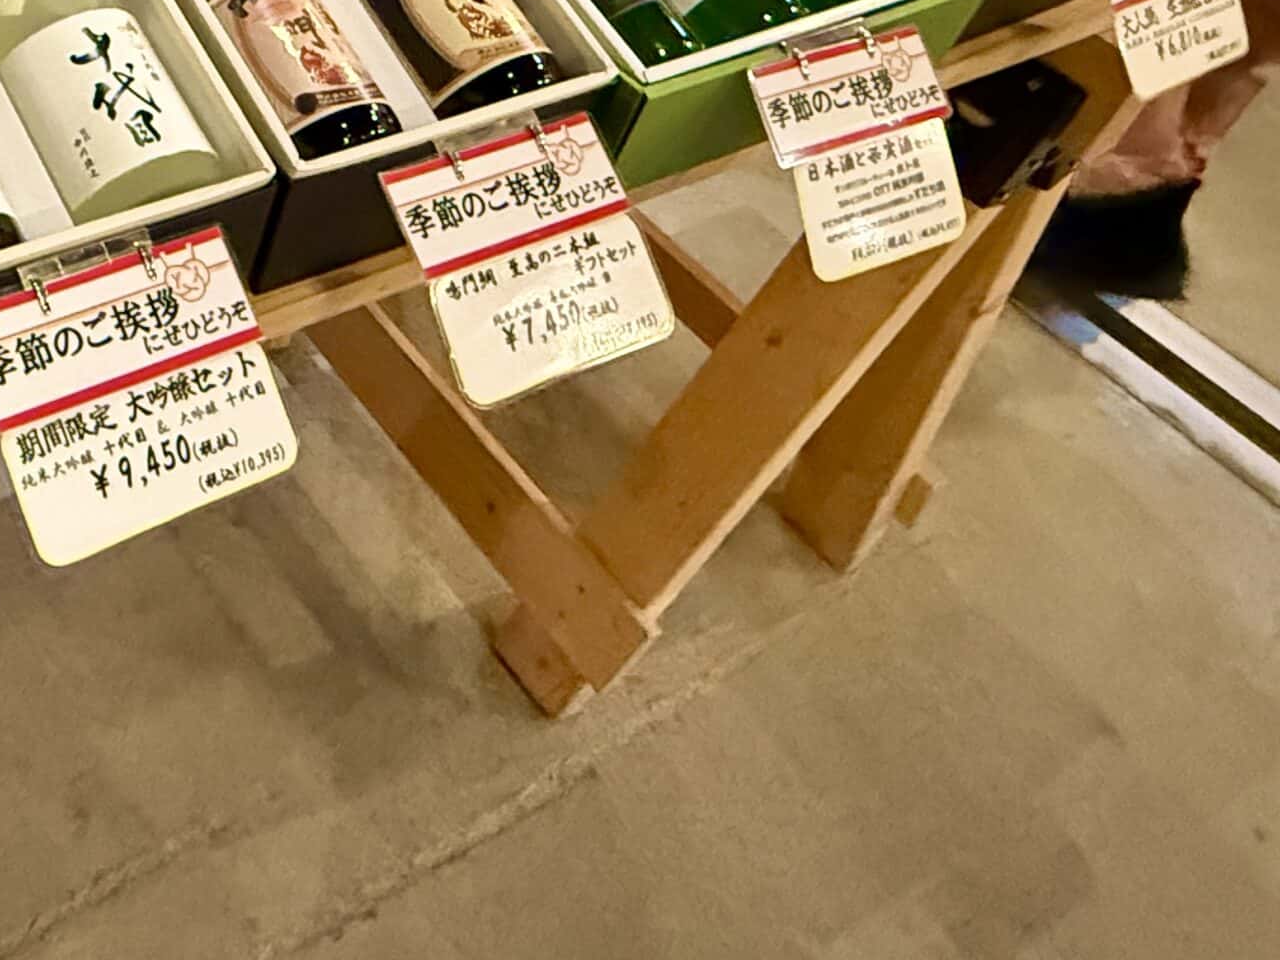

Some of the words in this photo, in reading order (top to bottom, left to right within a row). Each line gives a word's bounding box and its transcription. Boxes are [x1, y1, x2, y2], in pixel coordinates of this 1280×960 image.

[767, 67, 894, 130] 季節のご挨拶
[871, 84, 941, 118] にぜひどうぞ
[807, 135, 914, 183] 日本酒と果実酒
[405, 161, 562, 240] 季節のご挨拶
[533, 176, 621, 220] にぜひどうぞ
[573, 240, 638, 276] ギフトセット
[143, 300, 250, 356] にぜひどうぞ
[16, 404, 119, 465] 期間限定
[125, 350, 257, 424] 大吟醸セット
[103, 426, 148, 457] 十代目
[225, 381, 268, 408] 十代目
